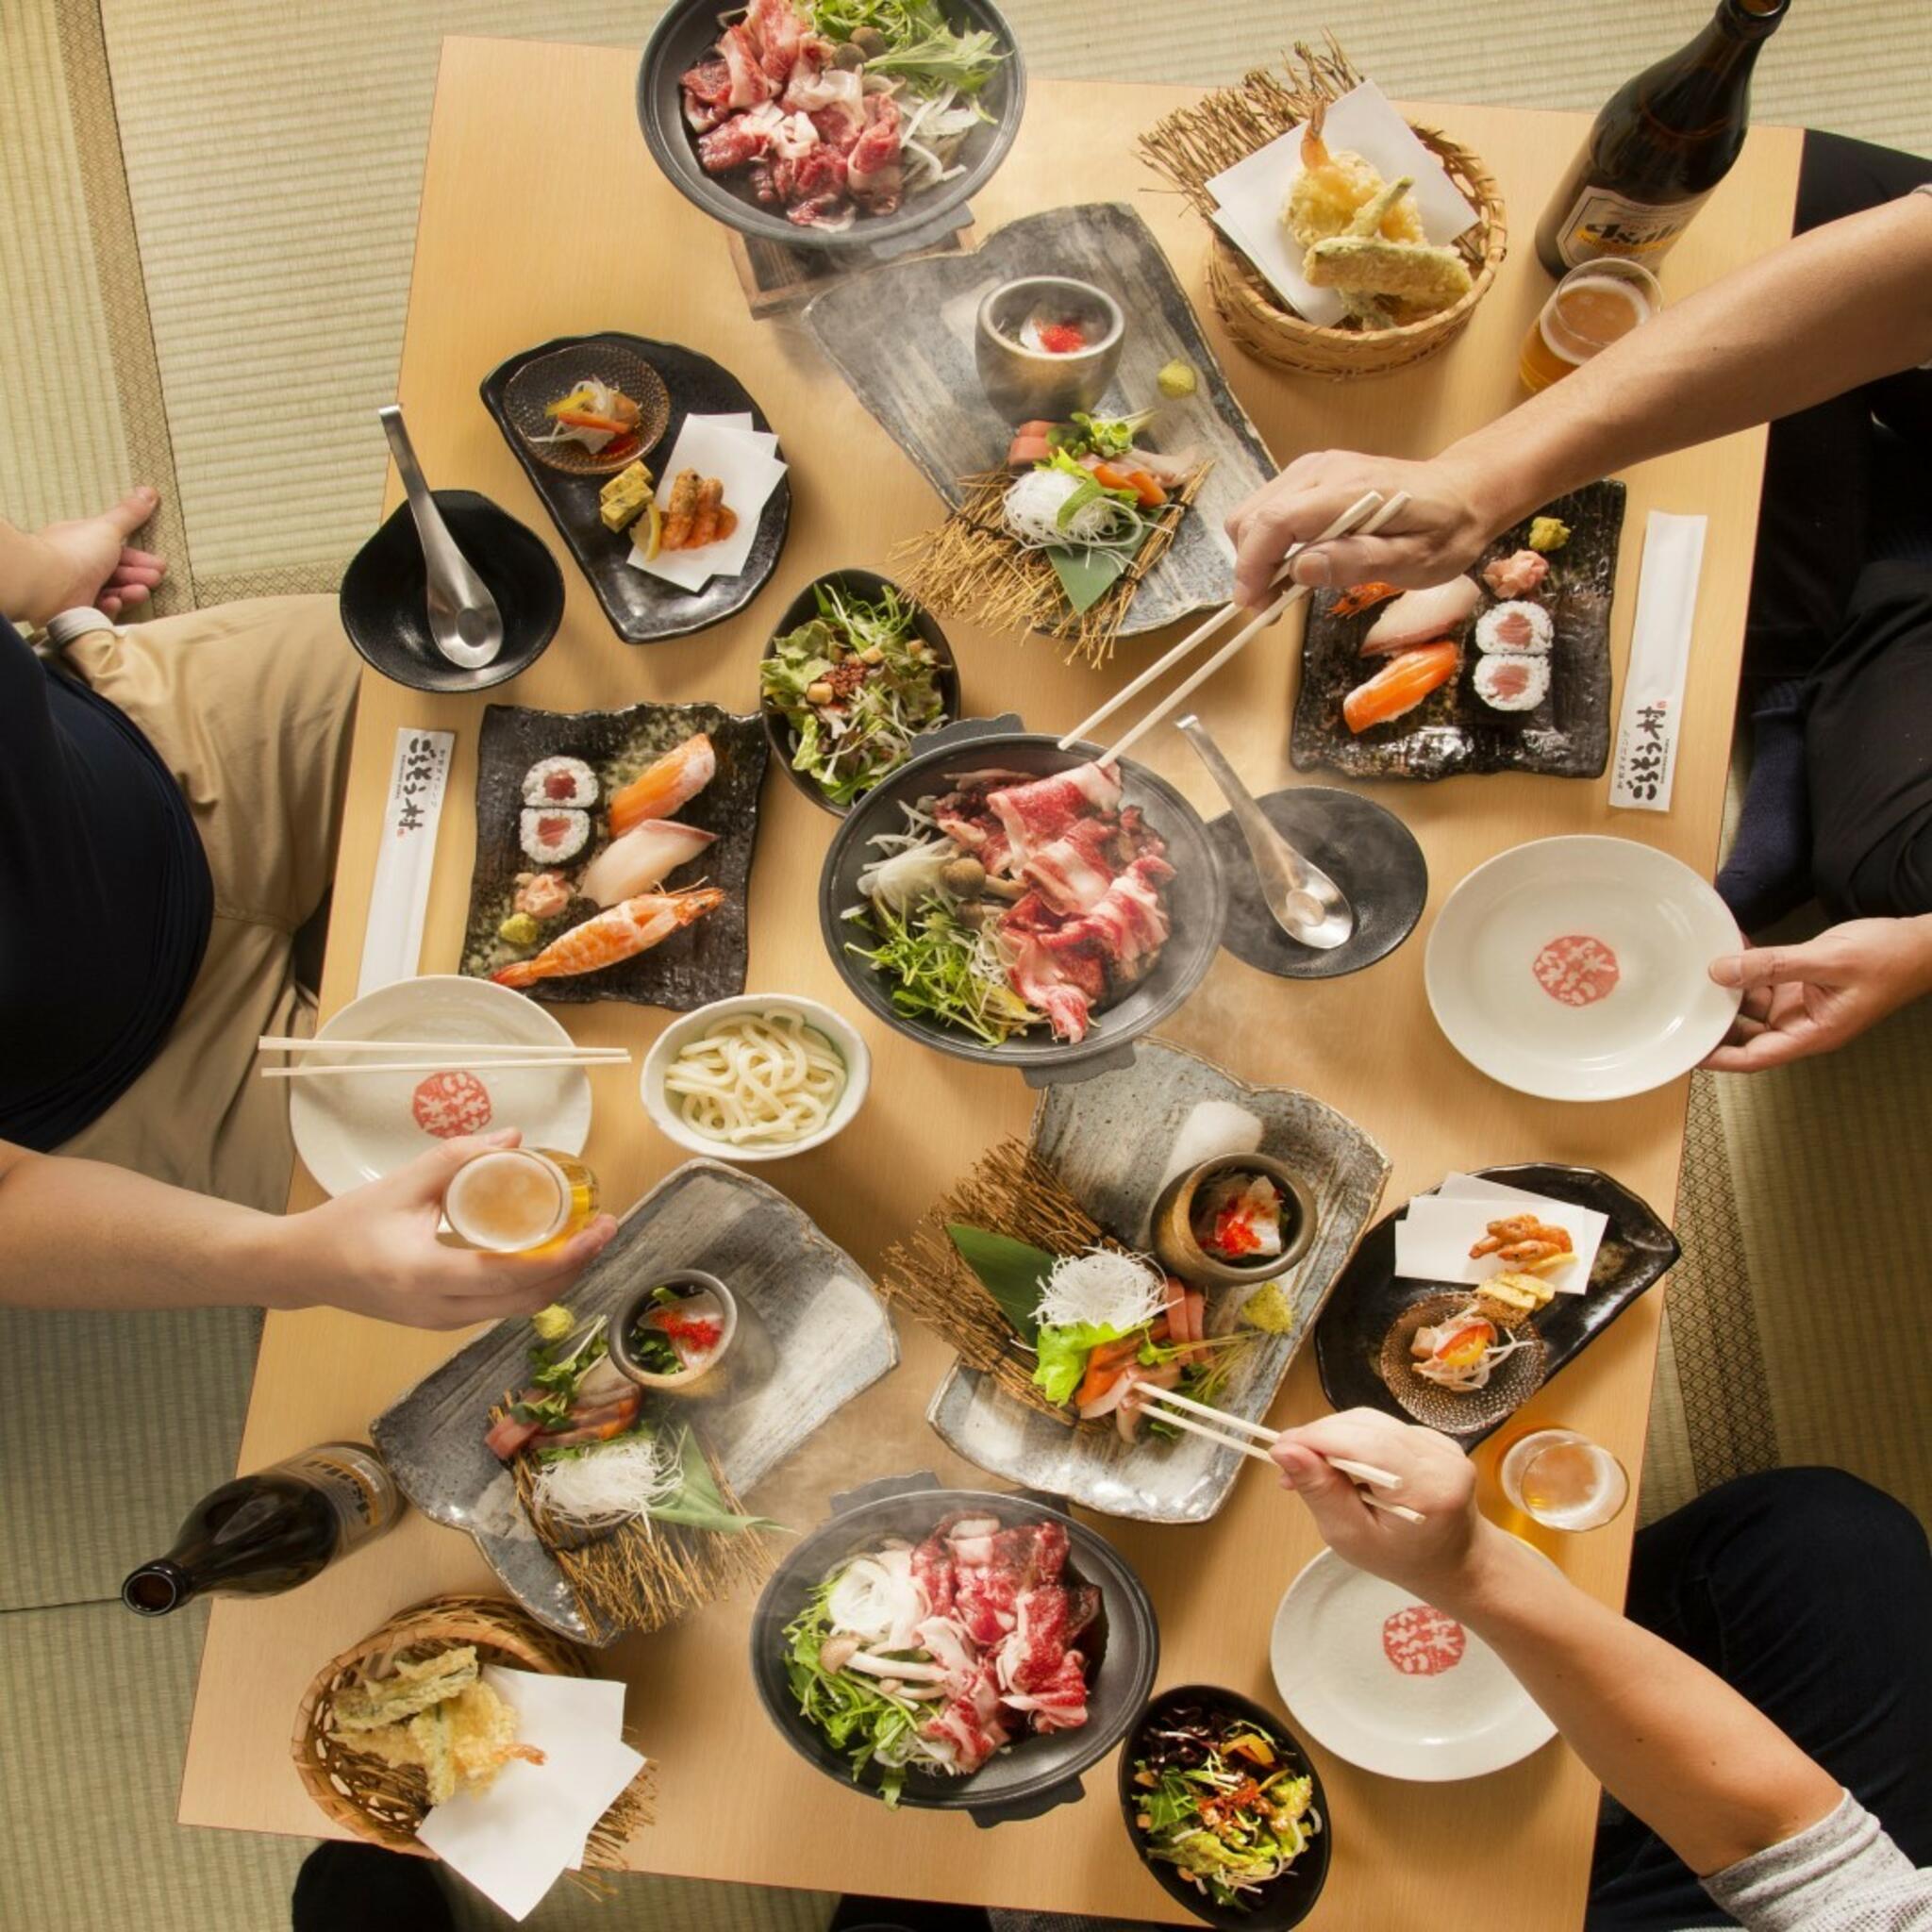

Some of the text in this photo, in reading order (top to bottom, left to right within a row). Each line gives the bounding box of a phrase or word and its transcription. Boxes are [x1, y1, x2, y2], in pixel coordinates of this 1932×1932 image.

[398, 737, 438, 831] ごちそう村
[1625, 706, 1667, 801] ごちそう村
